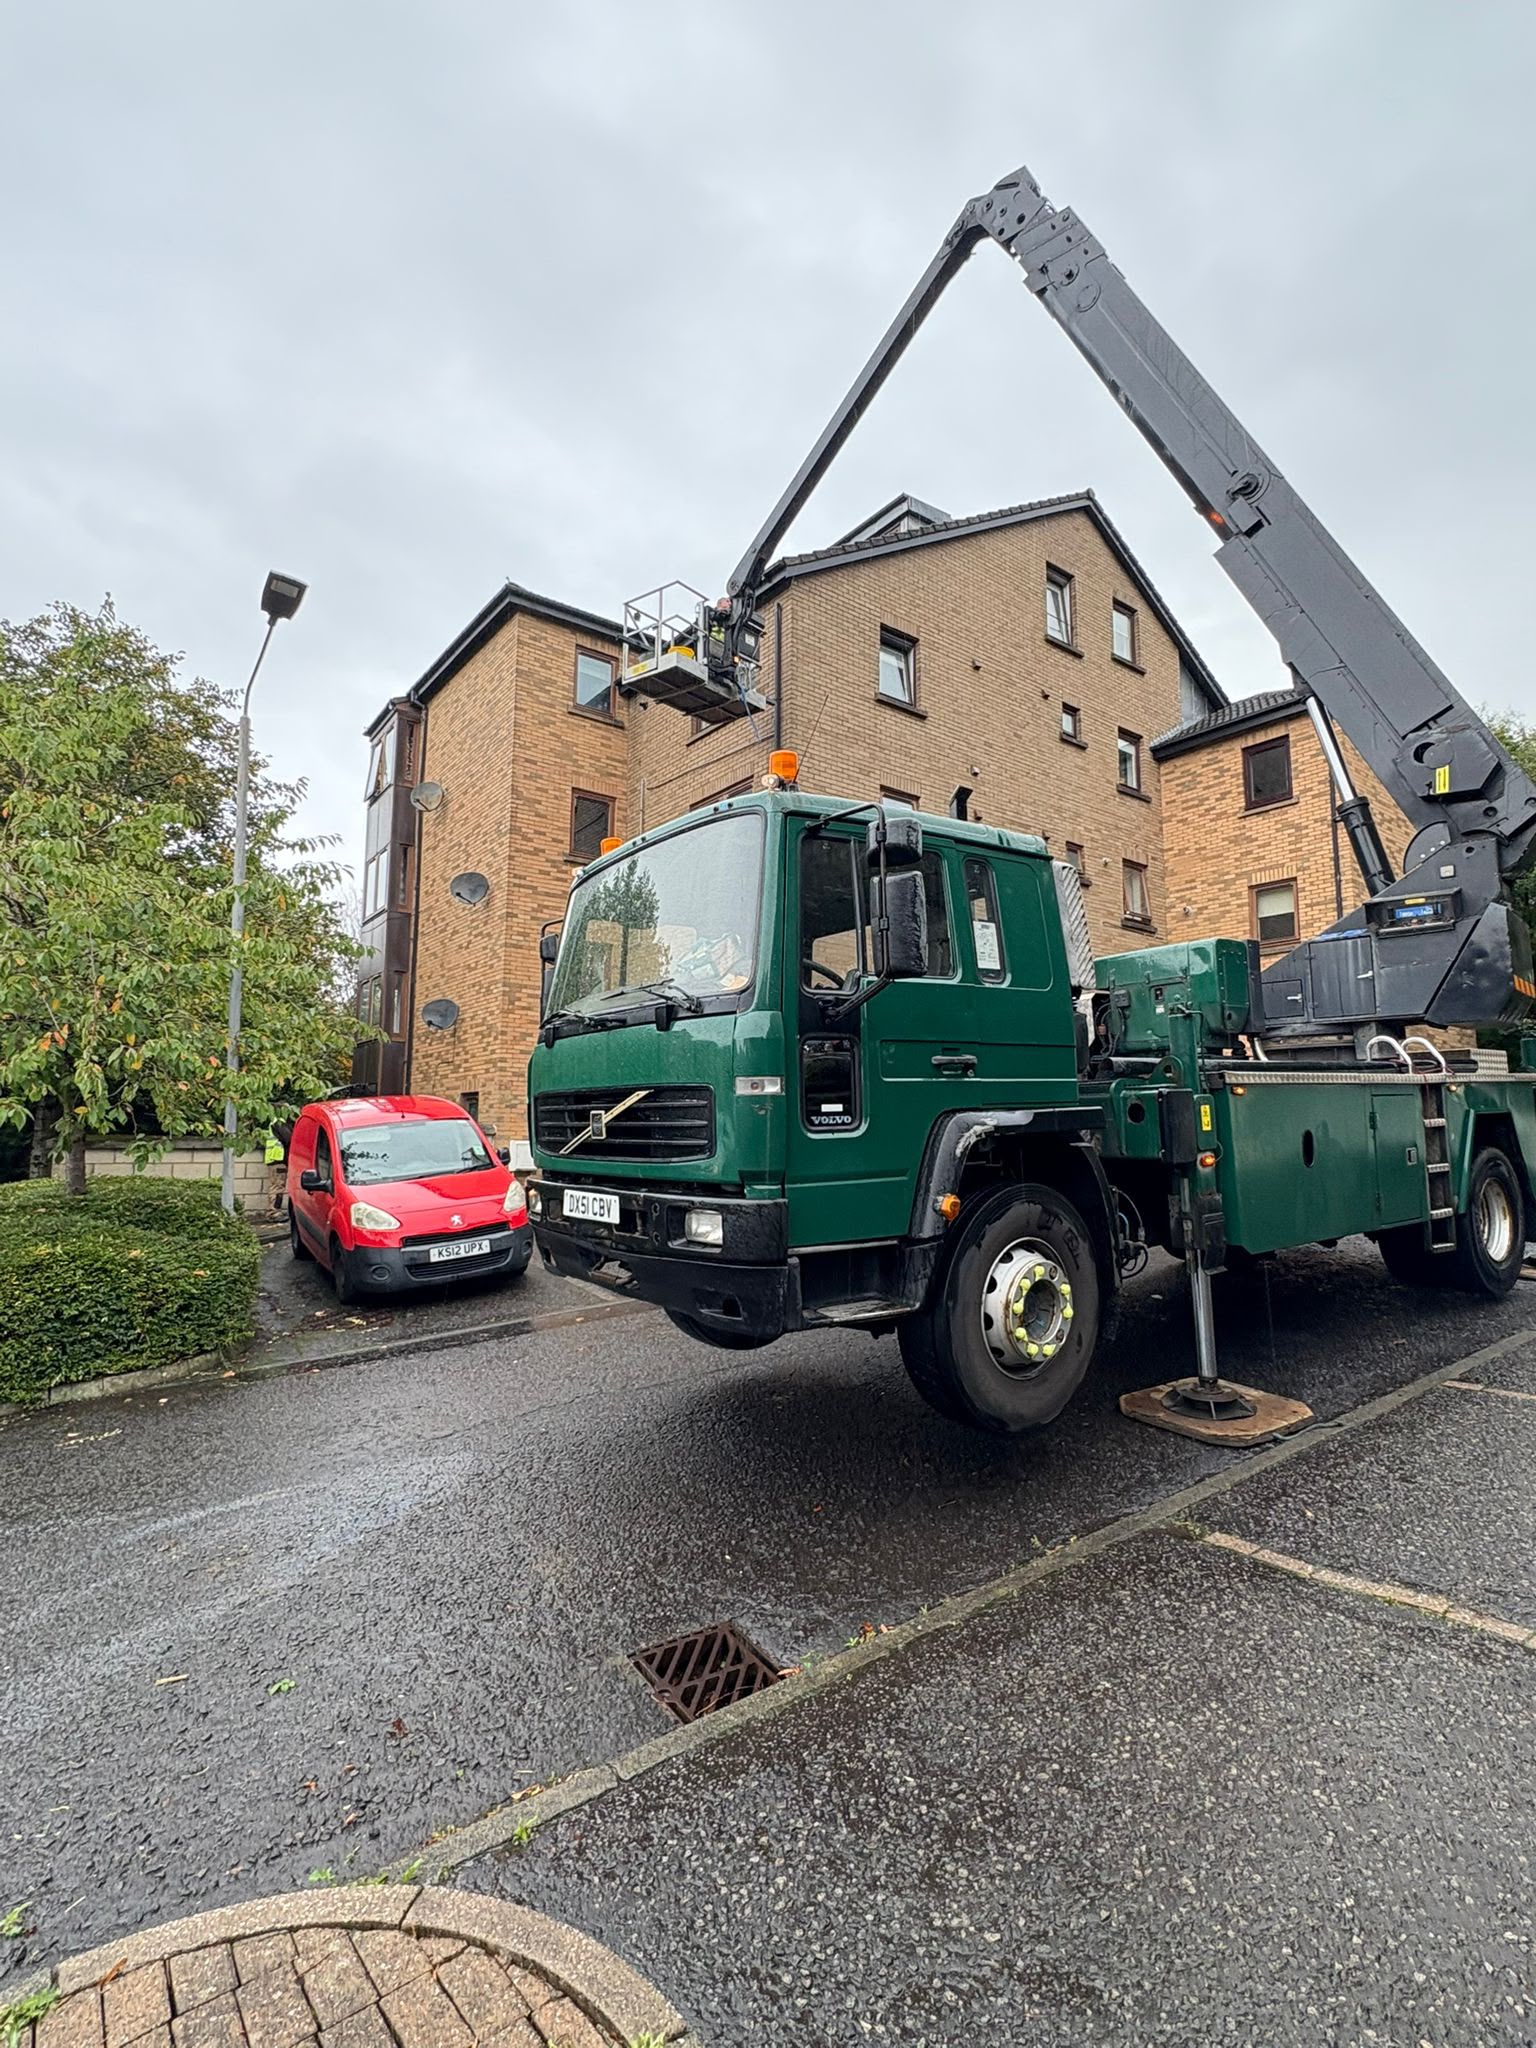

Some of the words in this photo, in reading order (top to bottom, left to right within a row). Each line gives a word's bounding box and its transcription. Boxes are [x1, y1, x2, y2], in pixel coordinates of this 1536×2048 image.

[811, 1115, 852, 1125] VOLVO
[569, 1194, 590, 1215] DX51
[437, 1246, 461, 1259] KS12
[463, 1242, 484, 1254] UPX
